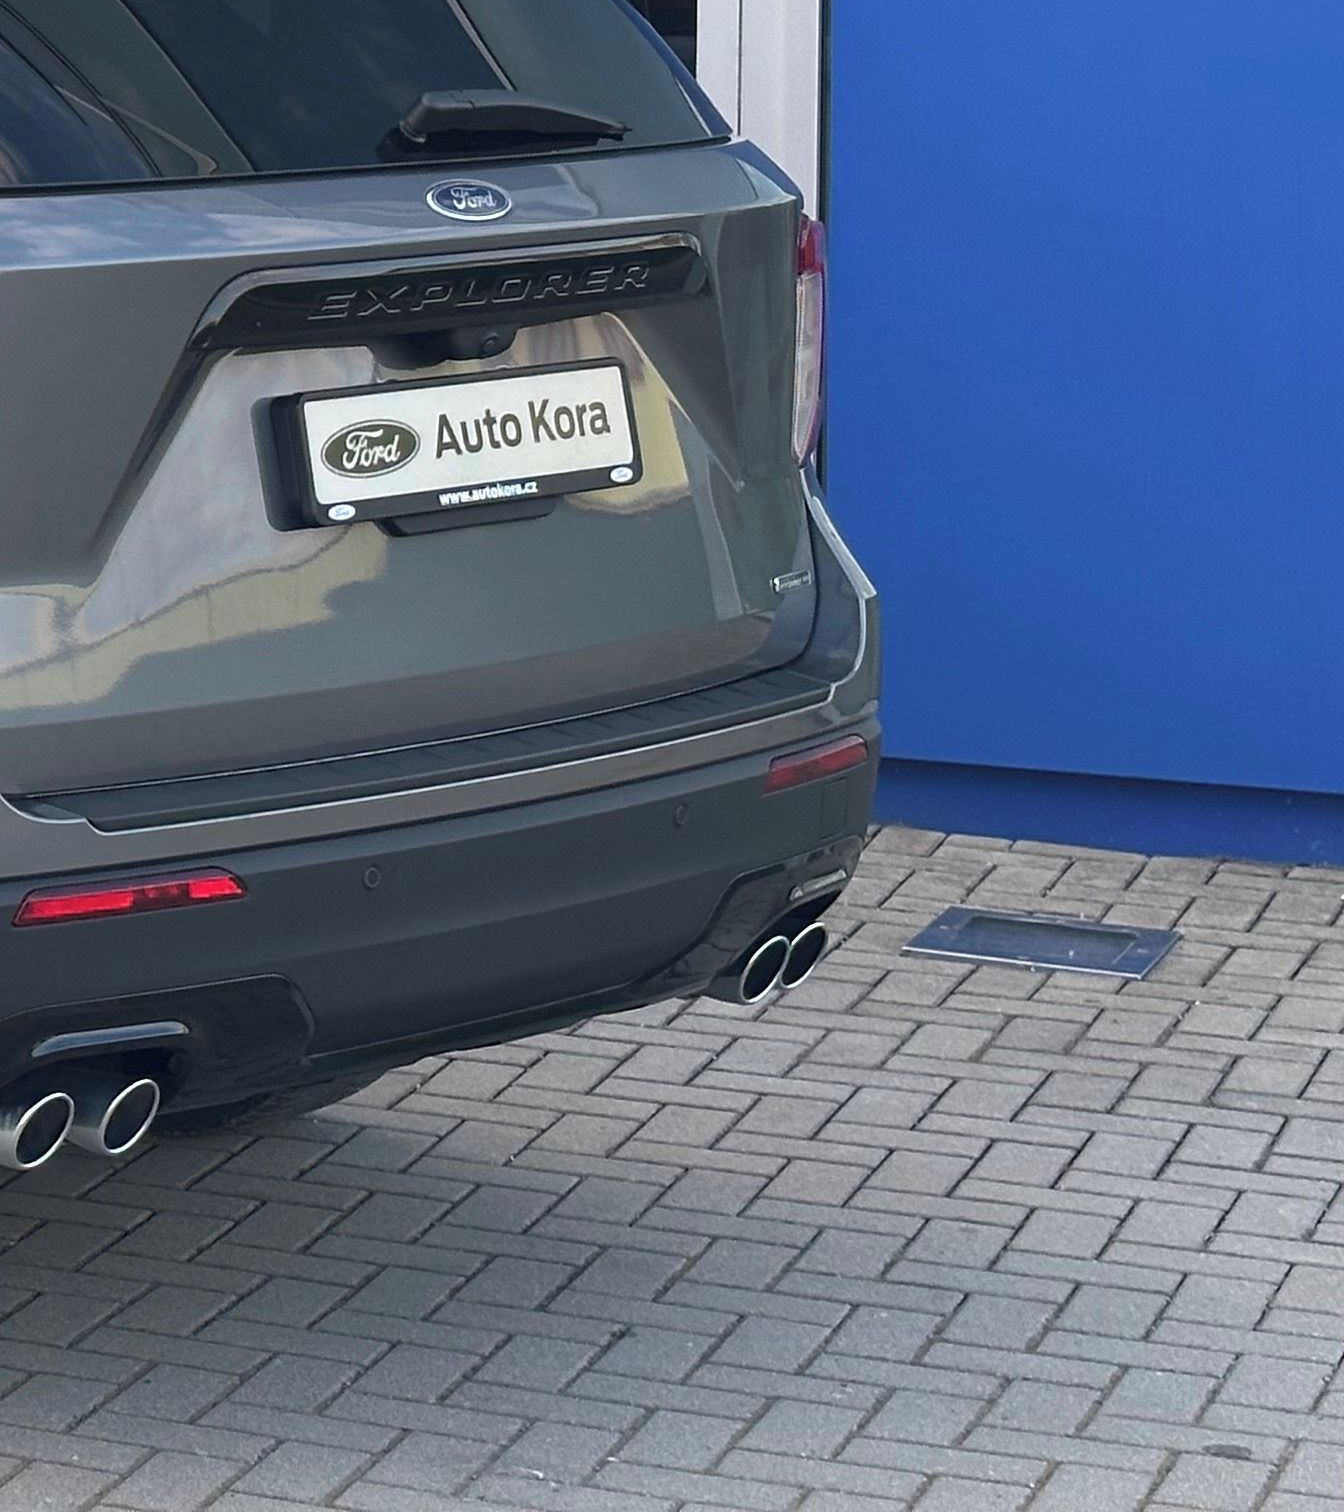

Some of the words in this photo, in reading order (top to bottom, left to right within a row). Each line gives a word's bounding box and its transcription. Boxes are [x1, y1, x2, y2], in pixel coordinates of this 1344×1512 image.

[452, 187, 497, 210] Ford
[307, 262, 652, 321] EXPLORER
[341, 428, 401, 471] Ford
[435, 408, 523, 460] Auto
[528, 397, 611, 444] Kora
[438, 481, 538, 506] www.autokora.cz
